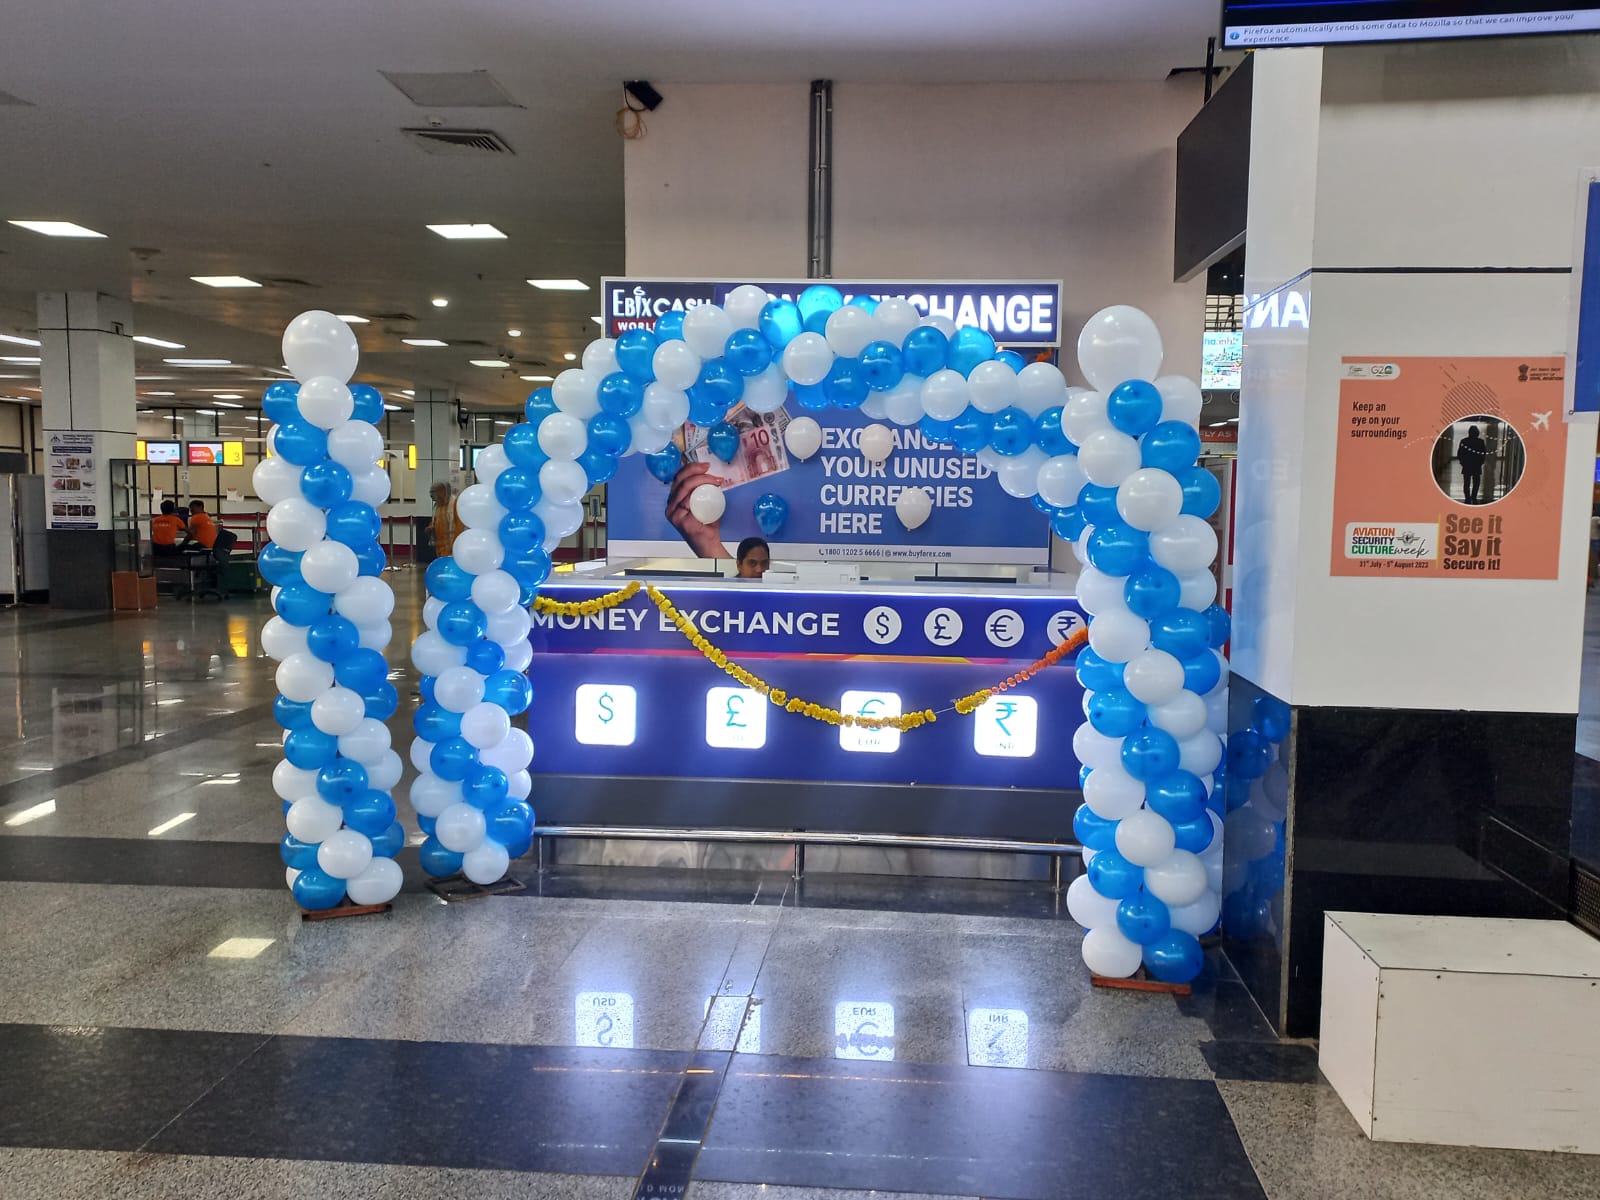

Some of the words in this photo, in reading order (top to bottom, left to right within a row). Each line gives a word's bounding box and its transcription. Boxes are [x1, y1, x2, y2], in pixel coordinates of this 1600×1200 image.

[1276, 24, 1333, 34] automatically
[1334, 23, 1359, 31] sends
[1420, 19, 1451, 27] Mozilla
[1516, 14, 1554, 23] improve
[1554, 14, 1575, 23] your
[867, 294, 1053, 333] HANGE
[617, 321, 656, 334] WORL
[1352, 401, 1374, 413] Keep
[1375, 403, 1386, 411] an
[1351, 416, 1367, 426] eye
[1368, 416, 1379, 425] on
[1381, 416, 1400, 427] your
[750, 429, 770, 449] 10
[1351, 428, 1407, 440] surroundings
[233, 452, 241, 462] 3
[820, 456, 887, 478] YOUR
[894, 456, 993, 480] UNUSED
[820, 484, 974, 508] CURREIES
[820, 512, 883, 535] HERE
[1446, 513, 1483, 534] See
[1488, 514, 1503, 534] it
[1352, 527, 1396, 537] AVIATION
[1351, 545, 1394, 555] CULTURE
[1394, 538, 1429, 558] week
[1352, 536, 1395, 545] SECURITY
[1444, 534, 1482, 558] Say
[1486, 535, 1502, 556] it
[825, 548, 841, 556] 1800
[892, 550, 952, 559] www.buyforex.com
[1370, 561, 1382, 569] July
[1395, 561, 1414, 569] August
[1443, 558, 1485, 570] Secure
[1488, 558, 1501, 570] it!
[529, 607, 648, 632] MONEY
[659, 609, 840, 636] EXCHANGE
